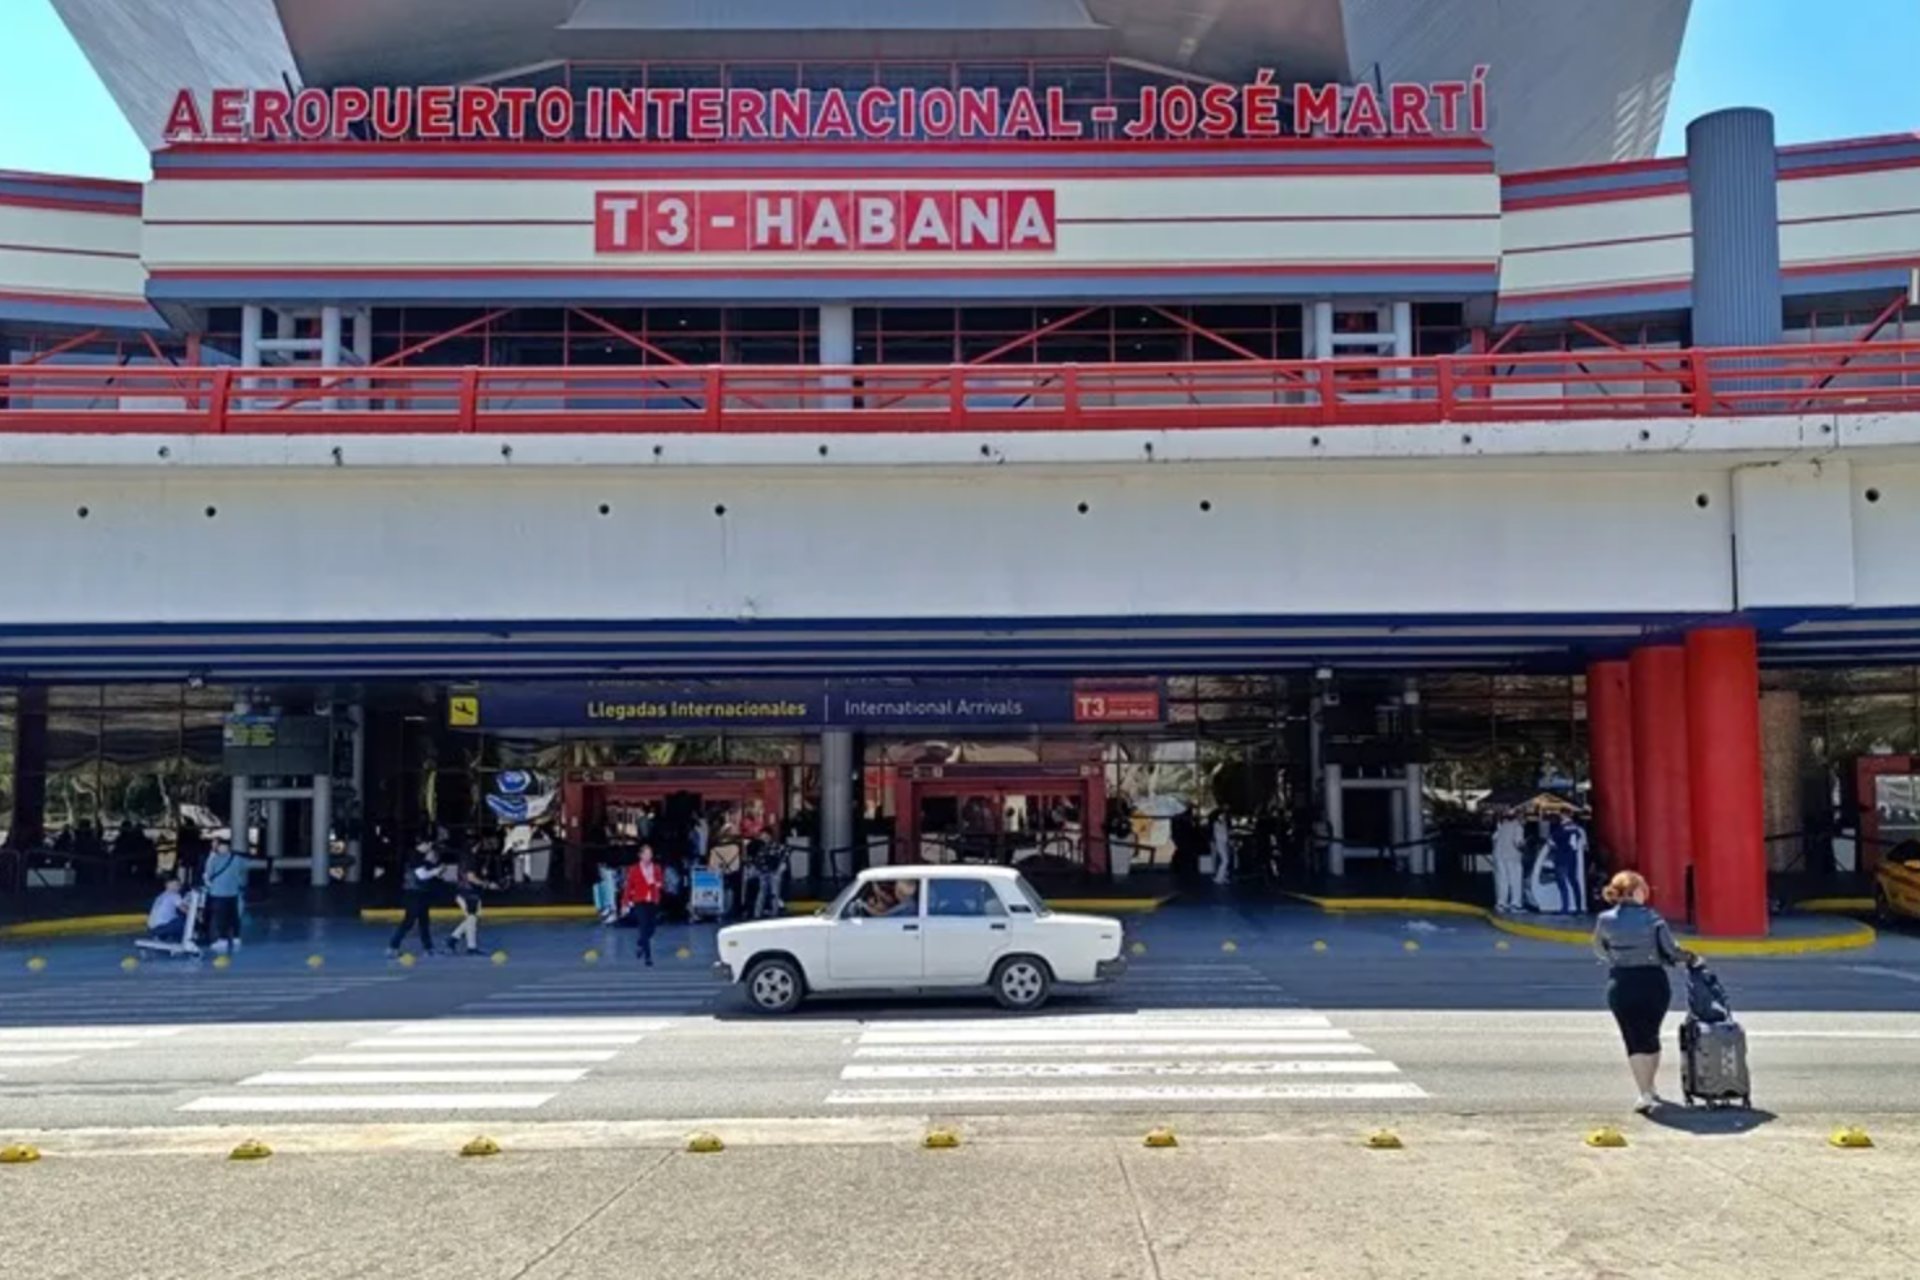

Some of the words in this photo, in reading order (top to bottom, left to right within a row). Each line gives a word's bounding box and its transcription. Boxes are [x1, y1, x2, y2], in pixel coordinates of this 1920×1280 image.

[164, 86, 574, 139] AEROPUERTO
[586, 86, 1083, 138] INTERNACIONAL
[1124, 69, 1280, 138] JOSÉ
[1293, 65, 1488, 137] MARTÍ
[587, 701, 667, 720] Llegadas
[670, 700, 807, 717] Internacionales
[844, 699, 951, 716] International
[957, 699, 1024, 716] Arrivals
[1078, 698, 1105, 717] T3
